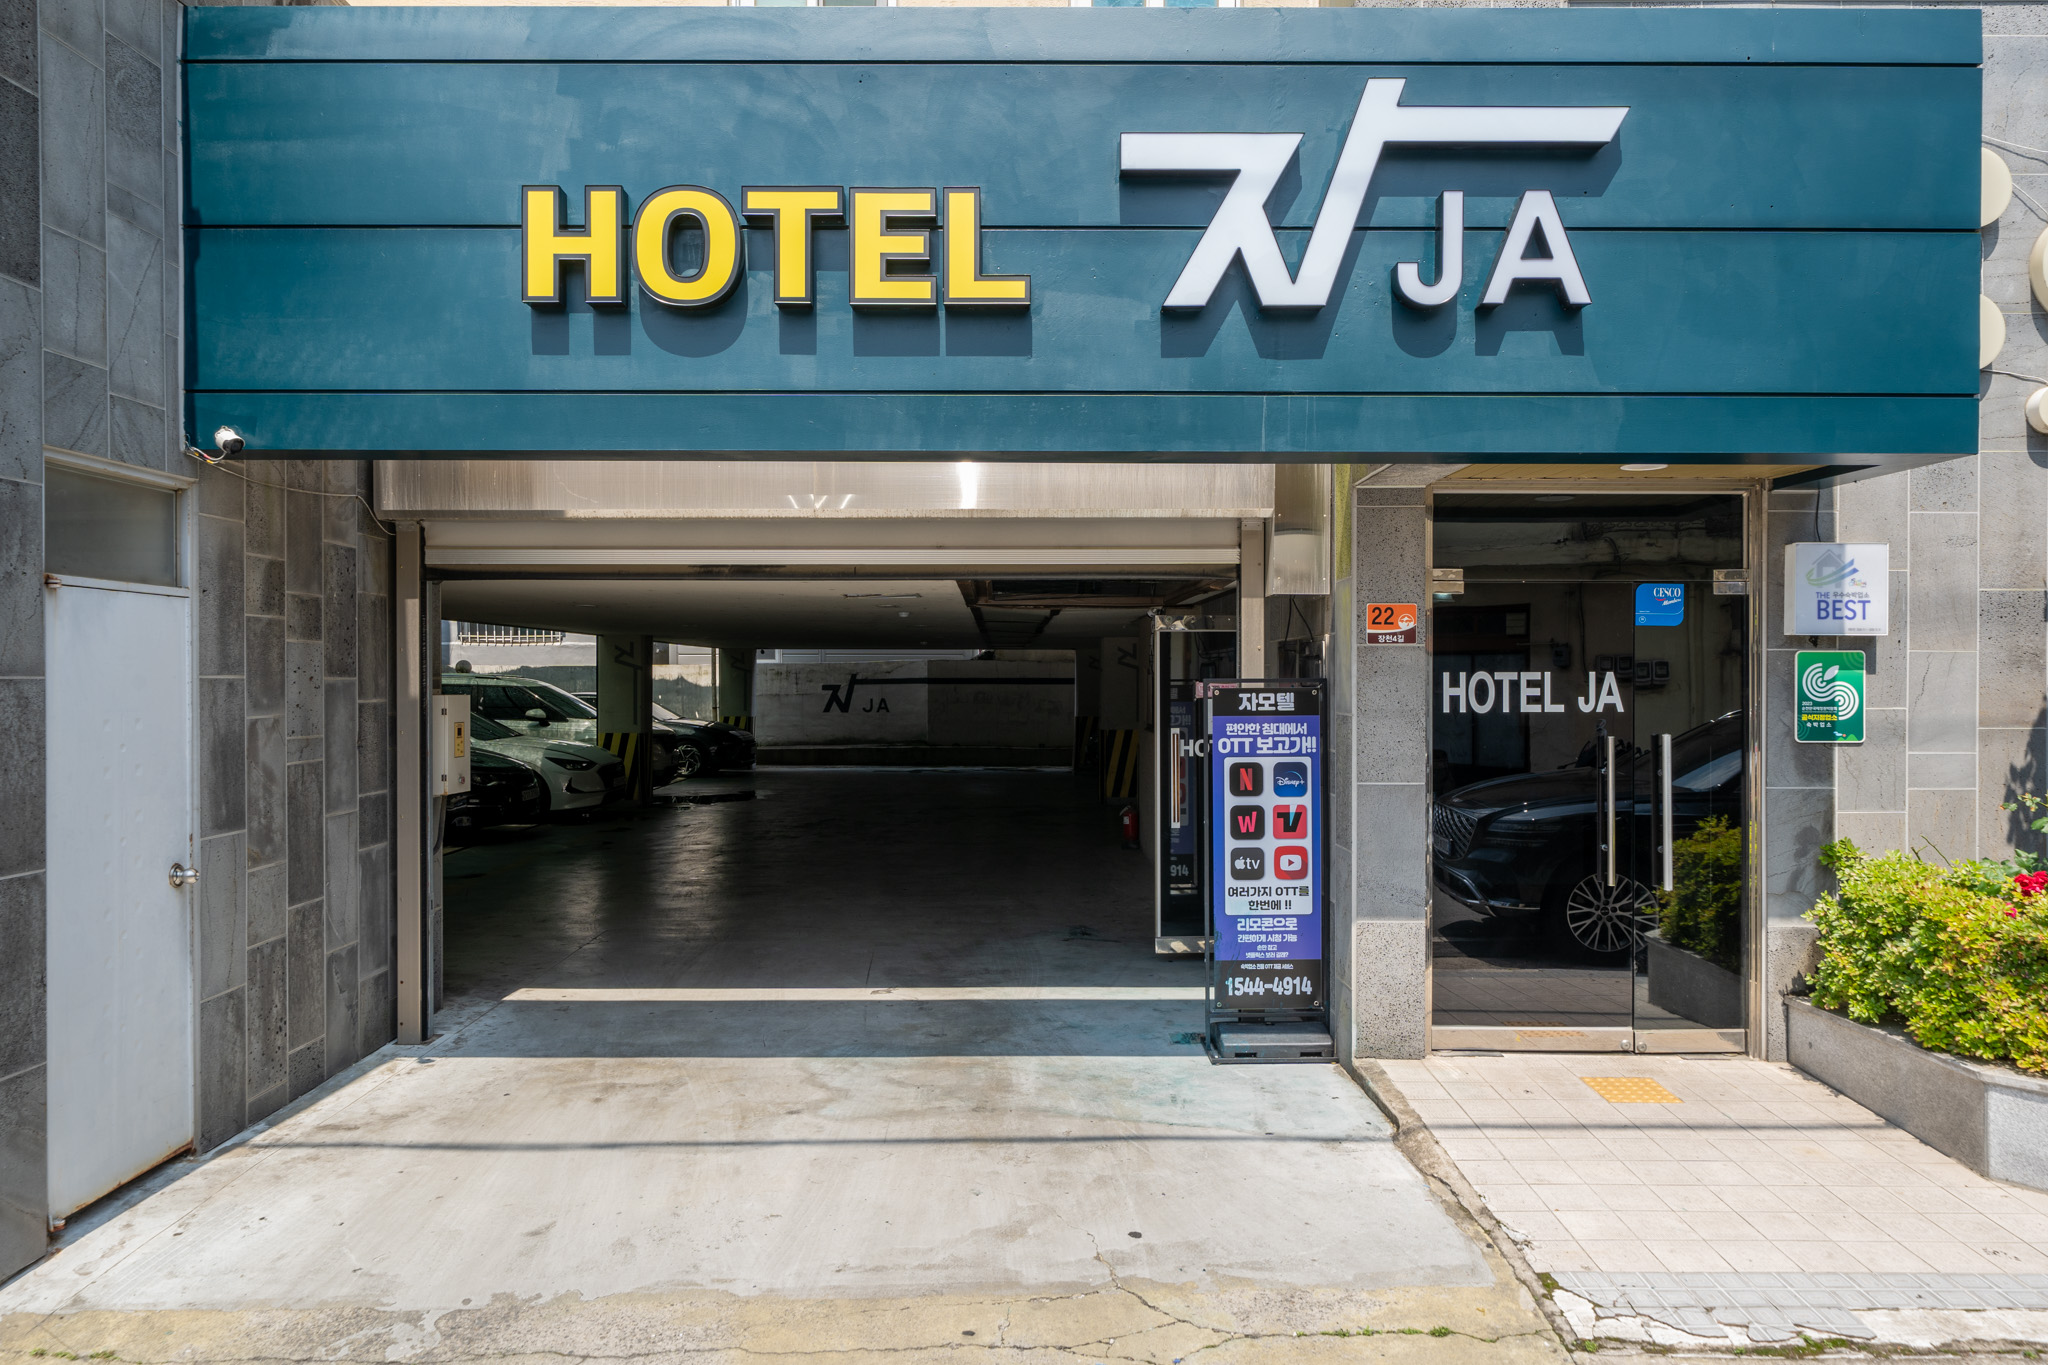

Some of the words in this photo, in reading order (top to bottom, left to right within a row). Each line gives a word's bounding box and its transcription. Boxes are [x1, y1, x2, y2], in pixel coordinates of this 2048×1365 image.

[522, 184, 1031, 308] HOTEL
[1393, 189, 1592, 312] JA
[1653, 587, 1681, 598] CESCO
[1816, 591, 1830, 599] THE
[1832, 591, 1870, 599] 우수숙박업소
[1371, 606, 1395, 625] 22
[1817, 599, 1871, 621] BEST
[1377, 634, 1405, 643] 장천4길
[1442, 671, 1565, 714] HOTEL
[1577, 671, 1625, 714] JA
[862, 697, 891, 713] JA
[1238, 691, 1296, 711] 자모텔
[1225, 722, 1261, 736] 편안한
[1262, 722, 1307, 736] 침대에서
[1217, 737, 1254, 754] OTT
[1256, 736, 1317, 755] 보고가!!
[1239, 768, 1253, 791] N
[1237, 811, 1258, 833] W
[1245, 856, 1261, 870] tv
[1227, 886, 1272, 897] 여러가지
[1248, 899, 1282, 911] 한번에
[1236, 917, 1298, 932] 리모콘으로
[1237, 934, 1266, 943] 간편하게
[1267, 933, 1282, 943] 시청
[1283, 933, 1298, 942] 가능
[1225, 976, 1313, 996] 1544-4914
